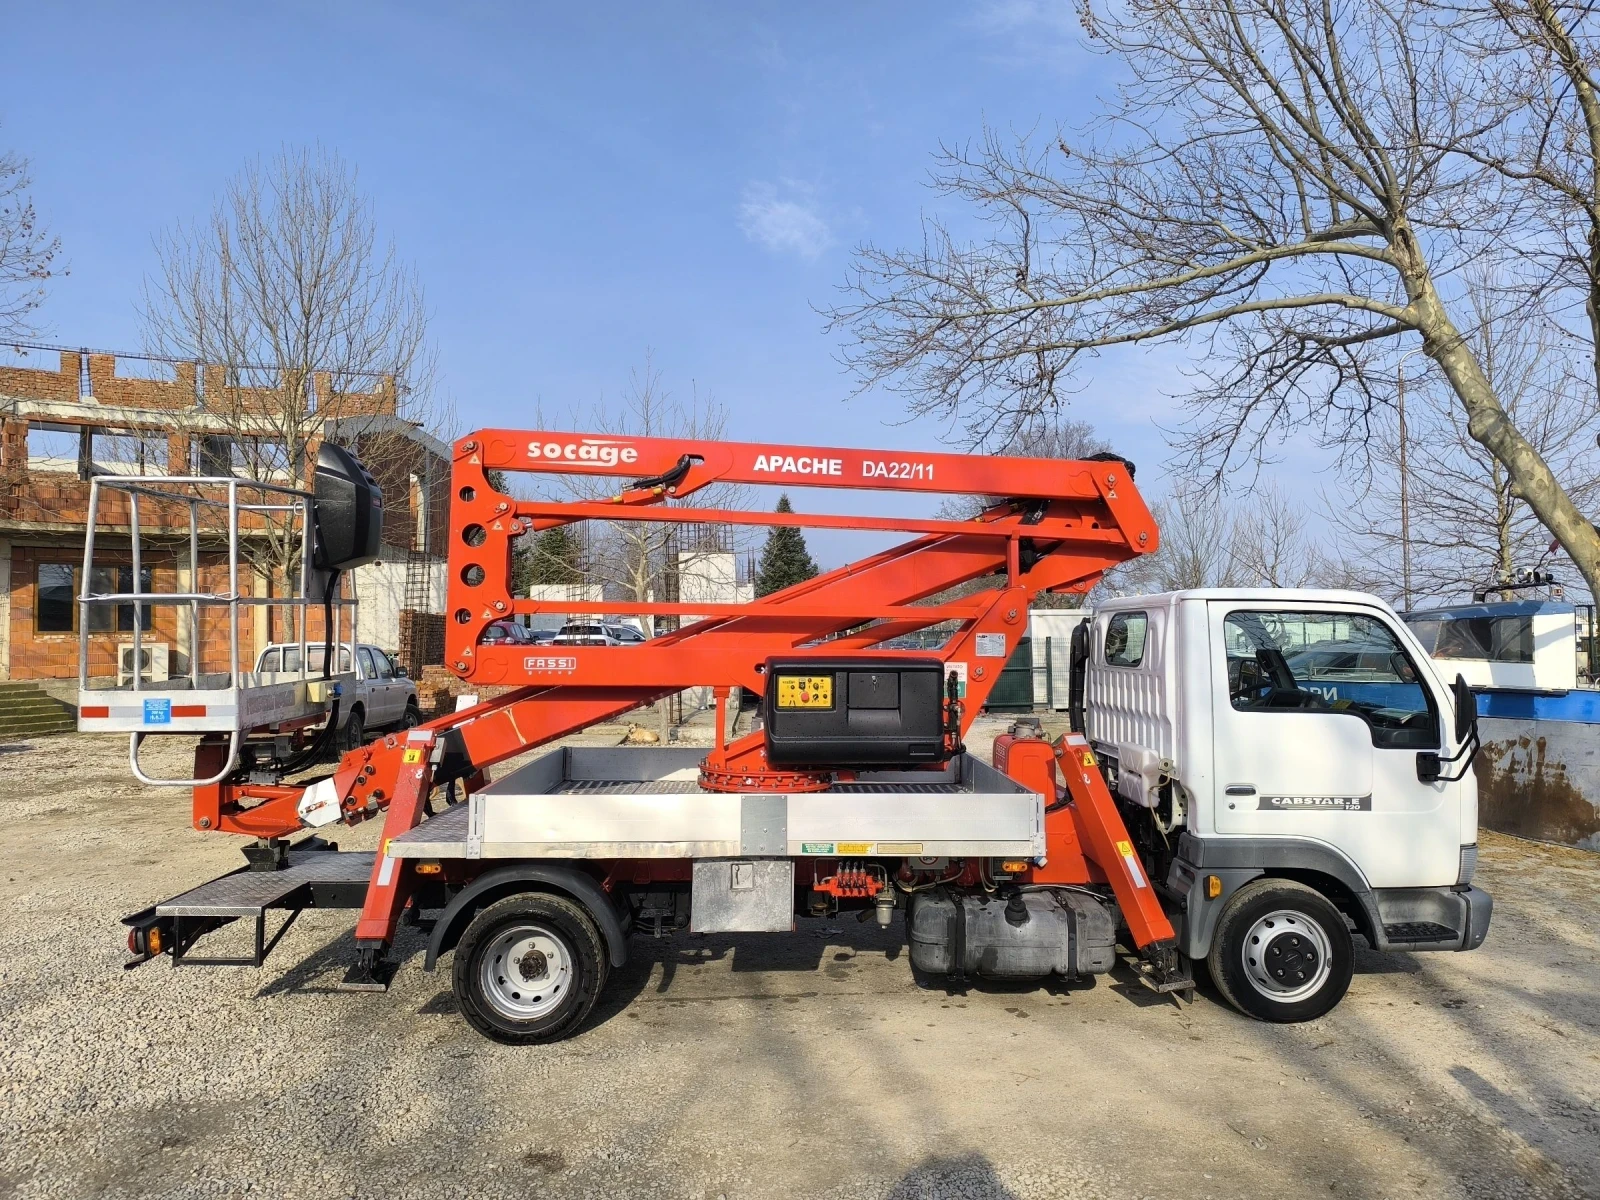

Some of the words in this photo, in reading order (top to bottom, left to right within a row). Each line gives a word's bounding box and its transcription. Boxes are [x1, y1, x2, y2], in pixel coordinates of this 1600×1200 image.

[526, 440, 638, 467] socage
[753, 455, 843, 475] APACHE
[862, 461, 934, 480] DA22/11
[527, 659, 572, 668] FASSI
